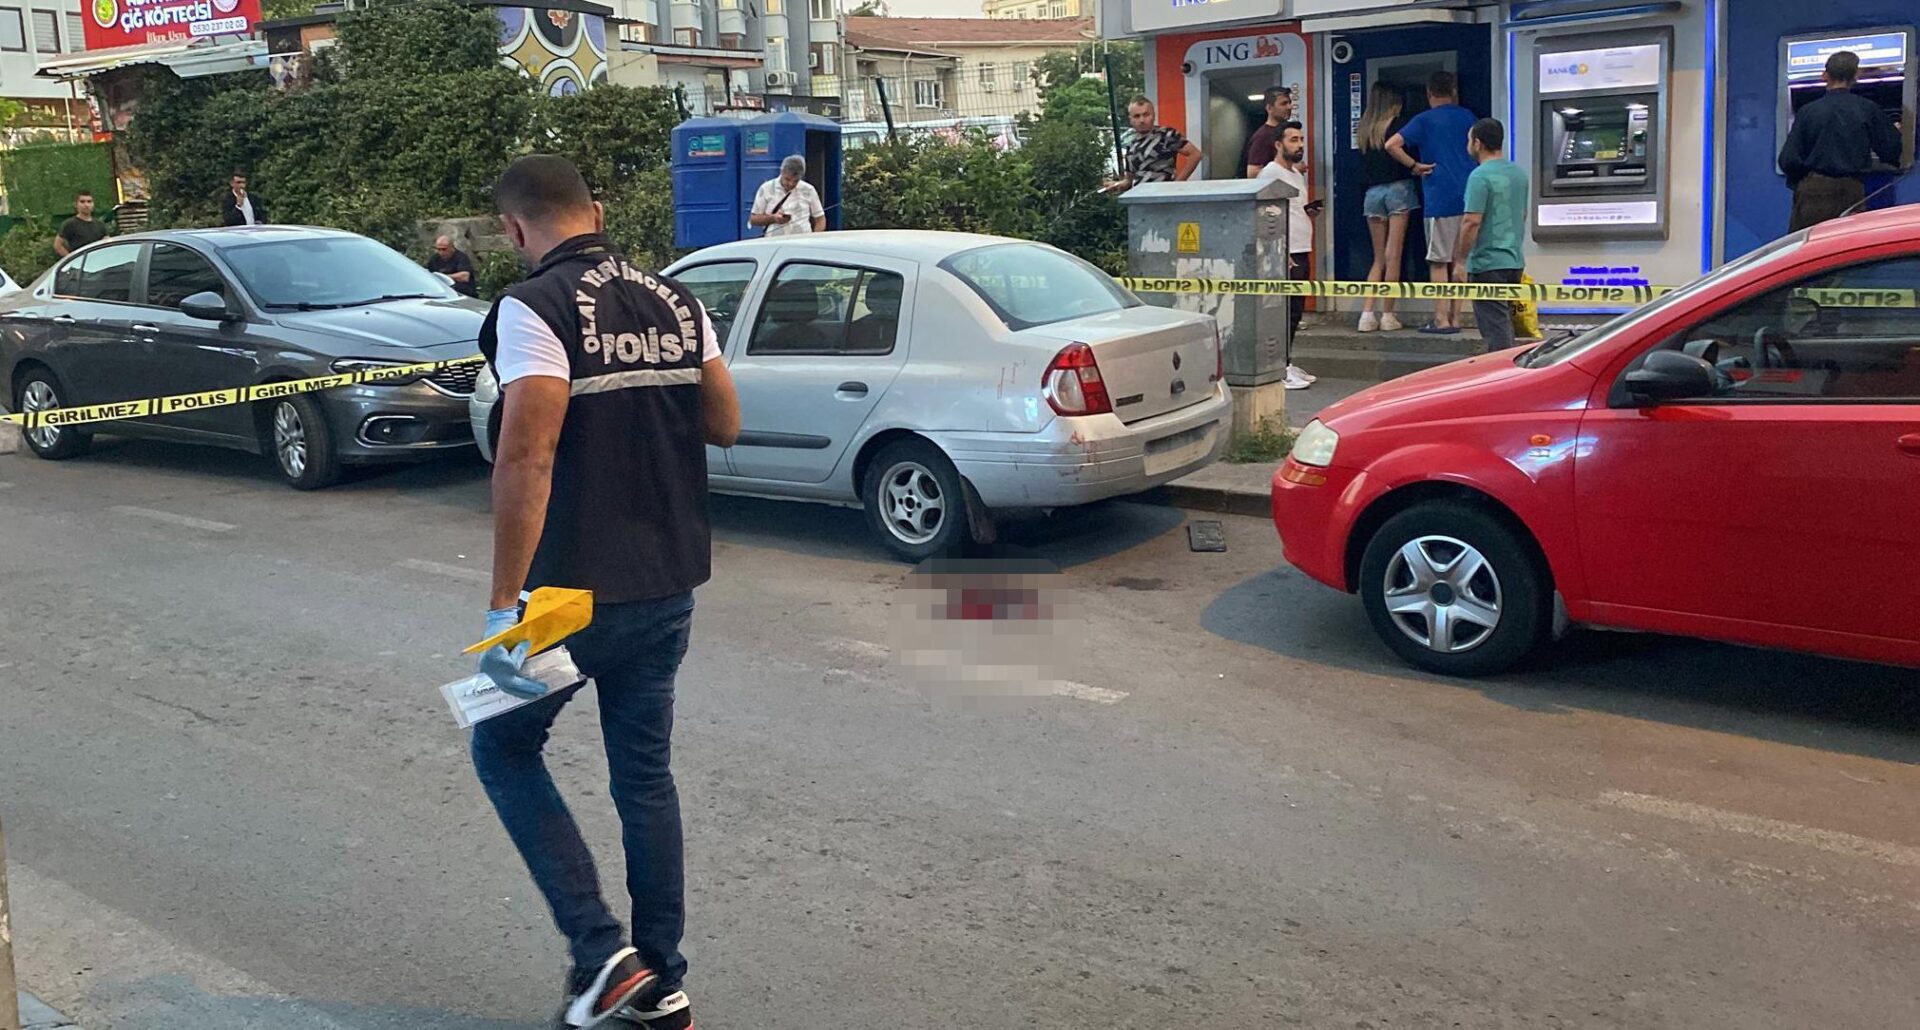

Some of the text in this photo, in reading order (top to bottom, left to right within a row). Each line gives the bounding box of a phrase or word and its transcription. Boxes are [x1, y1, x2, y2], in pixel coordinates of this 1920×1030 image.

[144, 0, 212, 27] KÖFTECİSİ
[1206, 43, 1251, 64] ING
[576, 289, 600, 354] OLAY
[620, 261, 697, 353] İNCELEME
[601, 327, 684, 365] POLİS
[44, 403, 141, 425] GİRİLMEZ
[170, 392, 228, 410] POLİS
[255, 377, 344, 399] GİRİLMEZ
